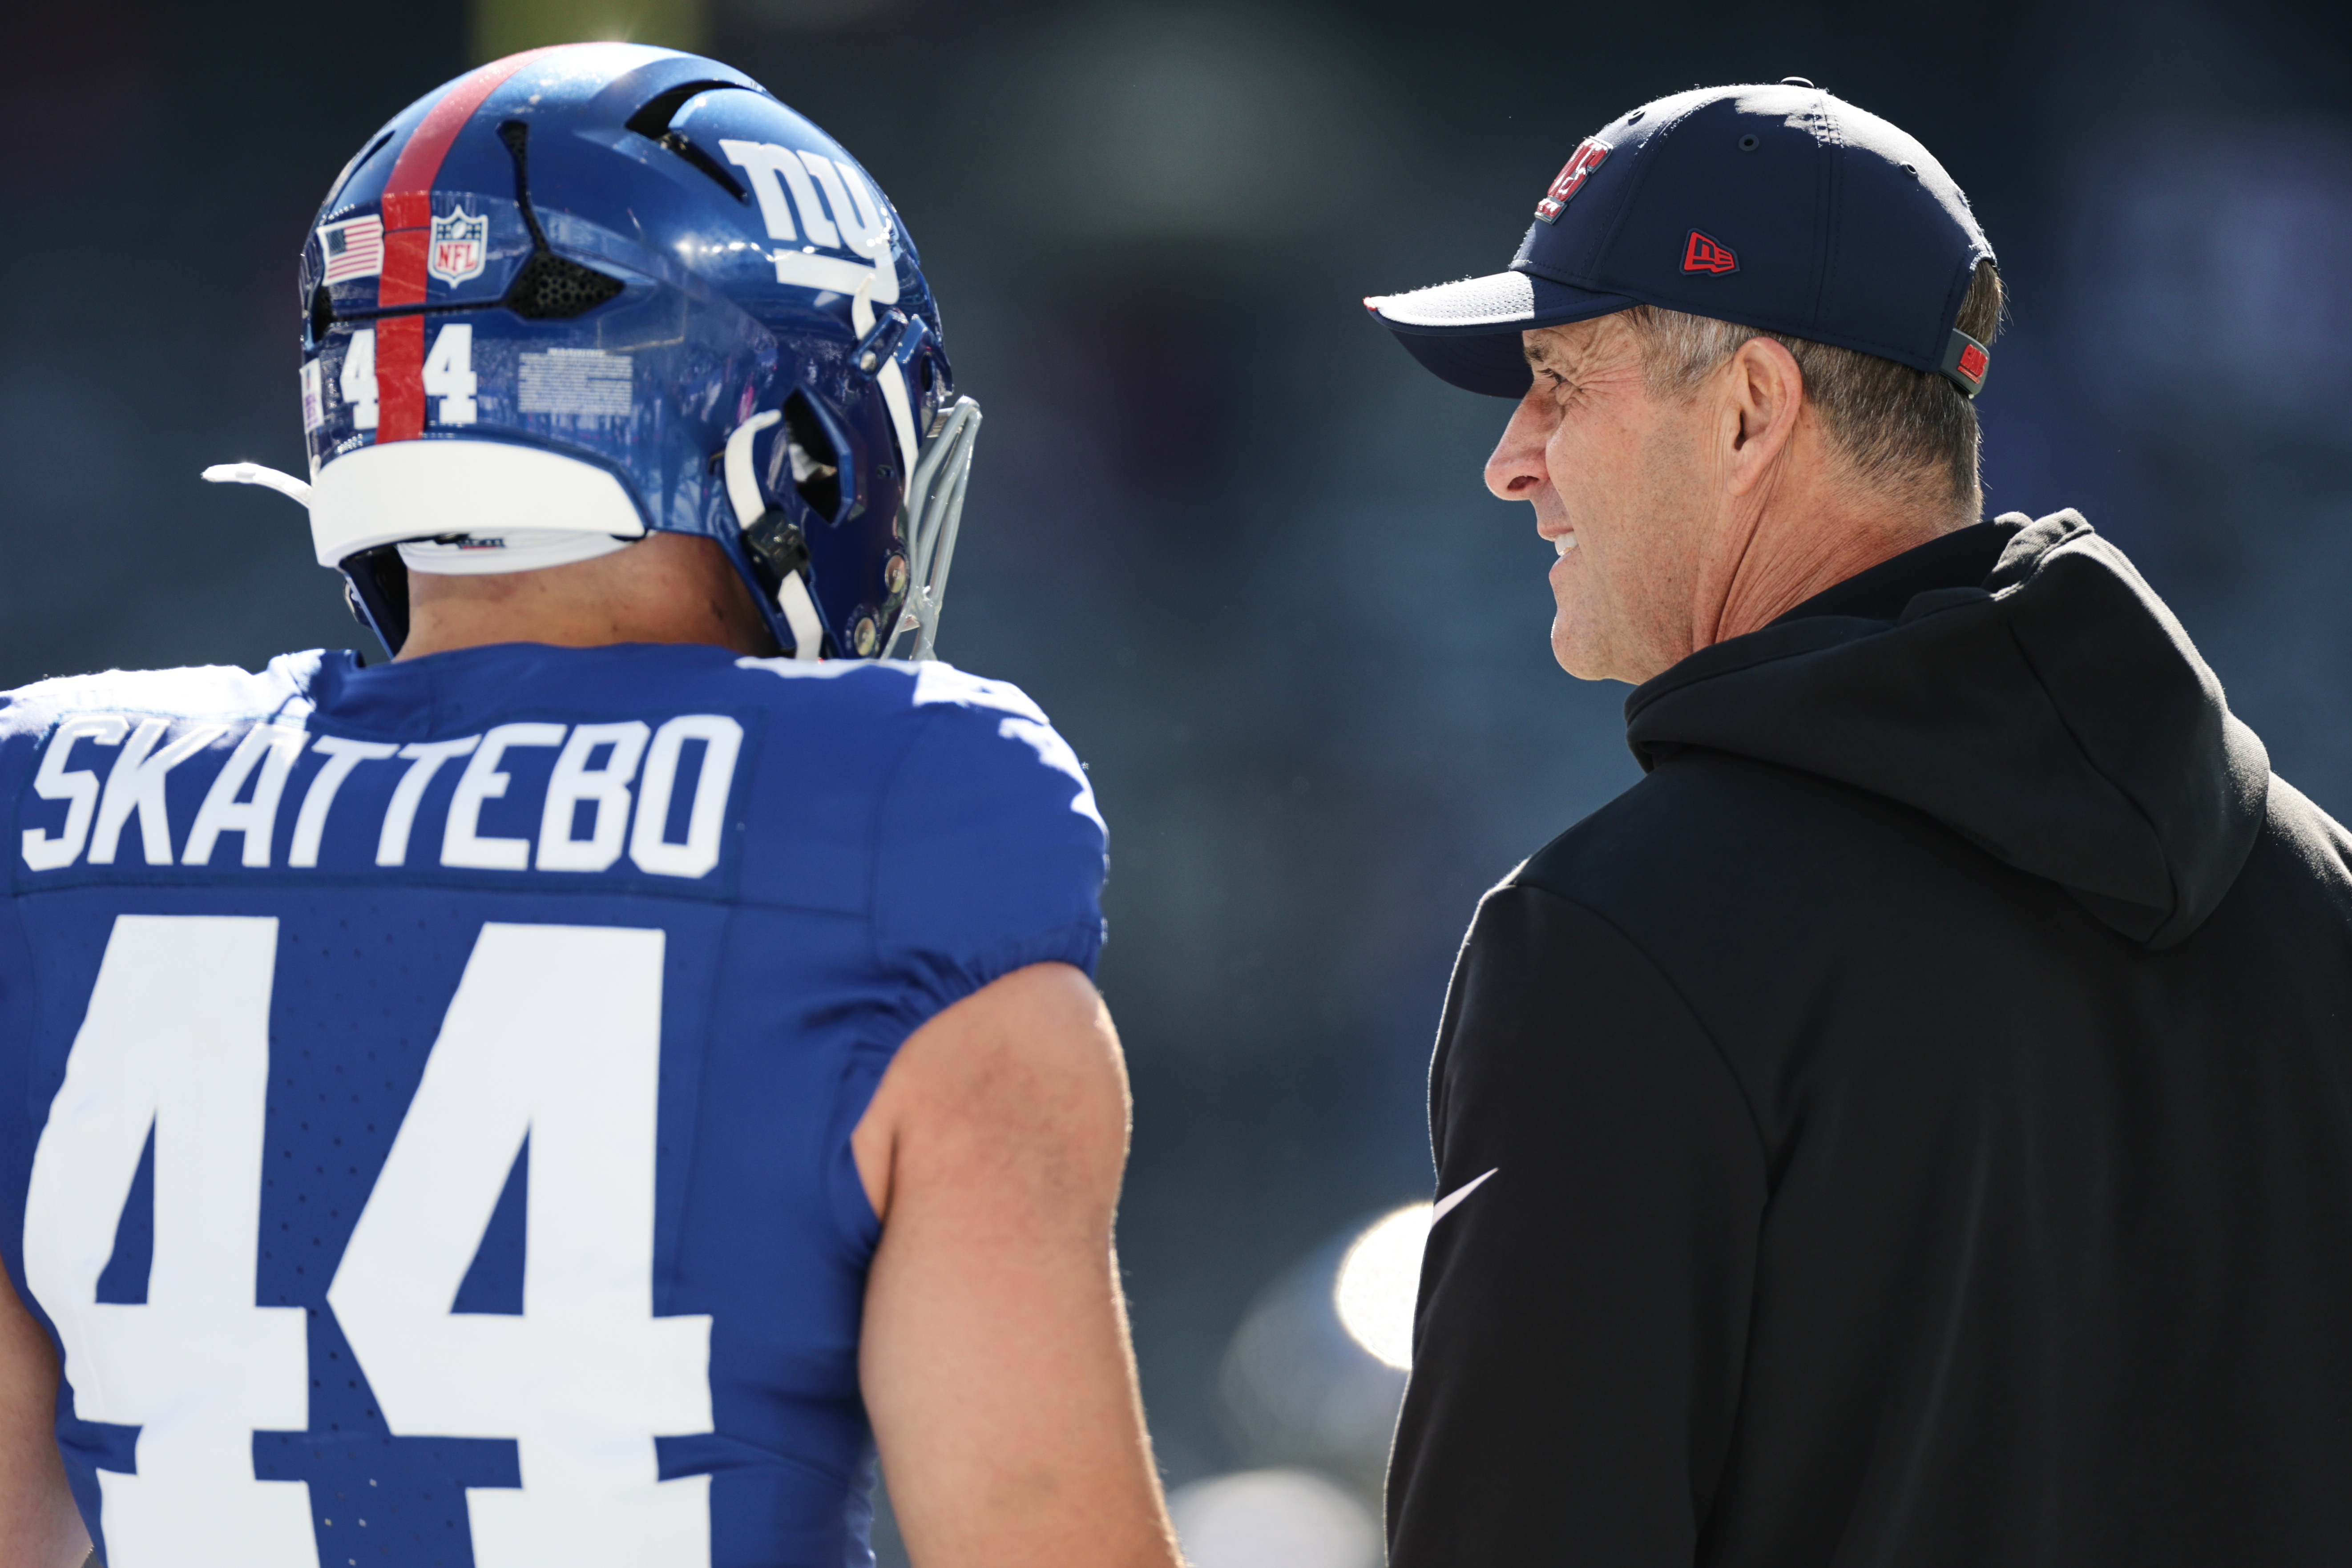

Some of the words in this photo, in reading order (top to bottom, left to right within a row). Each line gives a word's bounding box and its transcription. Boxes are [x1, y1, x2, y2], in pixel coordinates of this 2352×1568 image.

[437, 243, 478, 271] NFL
[22, 714, 744, 879] SKATTEBO
[23, 914, 714, 1568] 44
